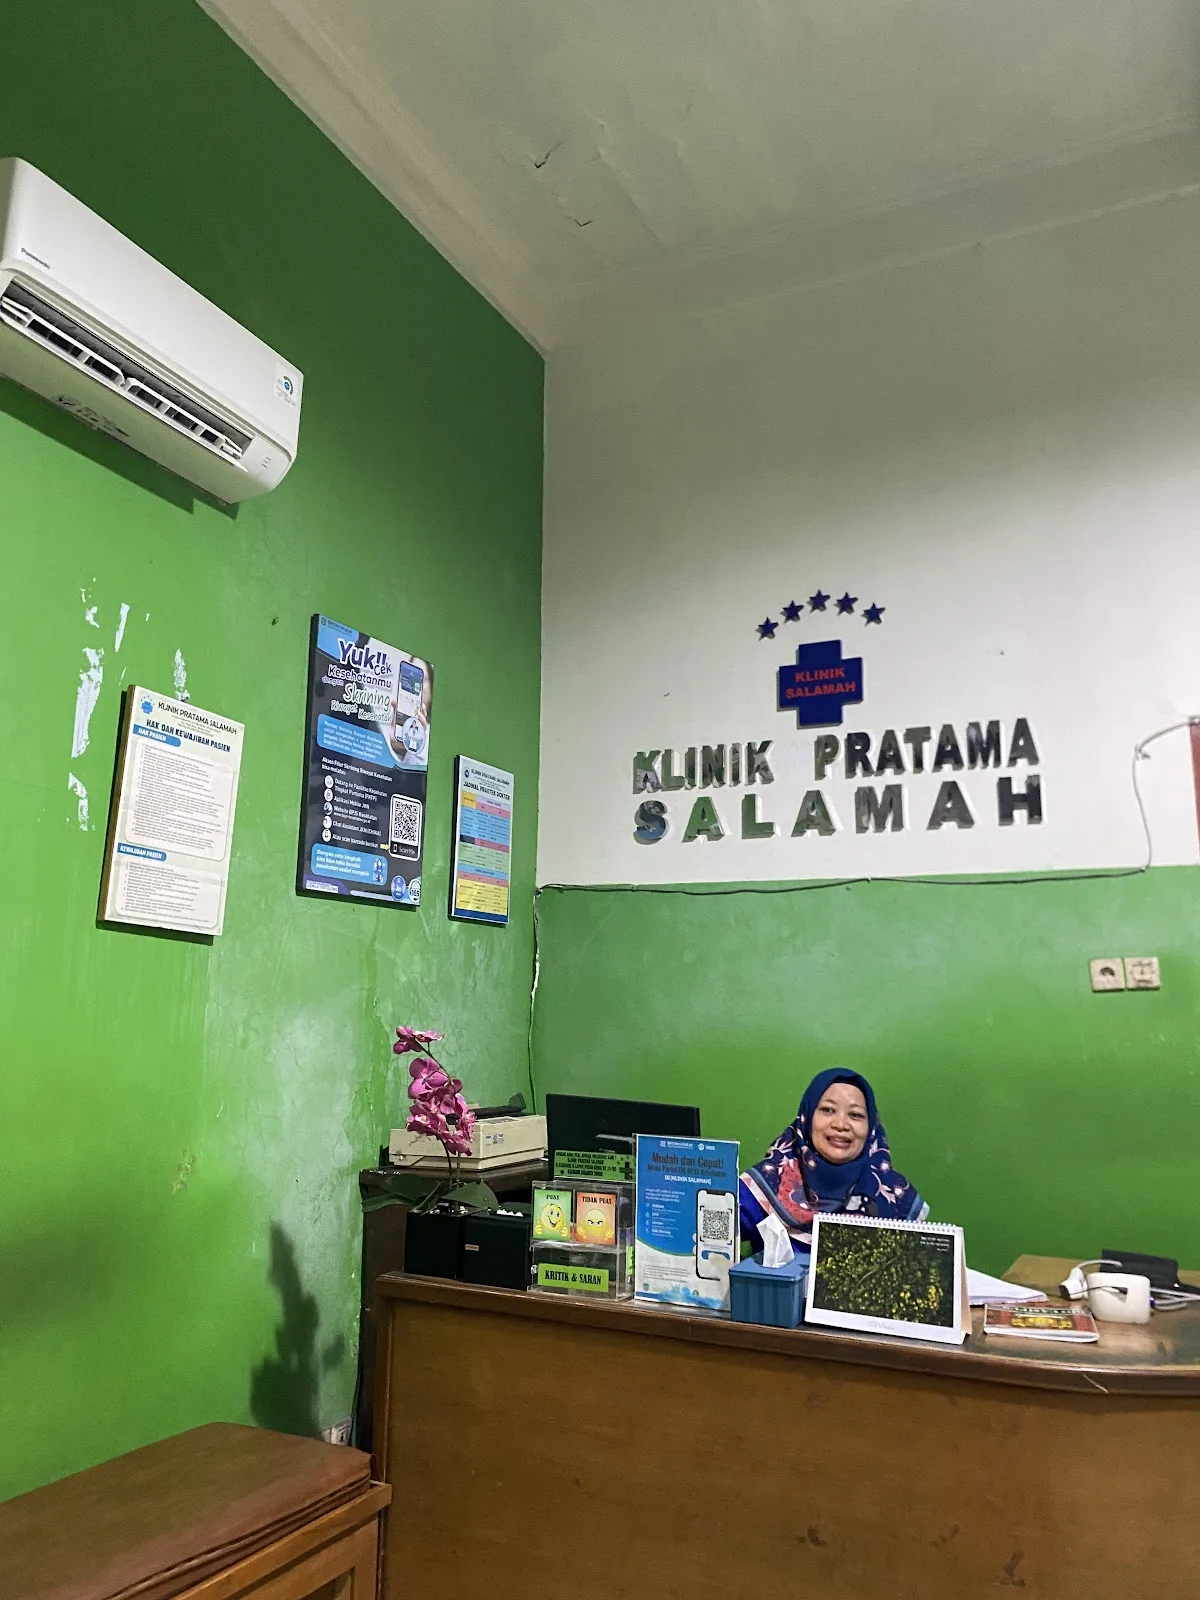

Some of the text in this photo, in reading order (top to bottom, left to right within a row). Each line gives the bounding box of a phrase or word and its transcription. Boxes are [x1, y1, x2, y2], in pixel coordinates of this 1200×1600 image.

[338, 639, 387, 670] Yuk!!
[328, 664, 392, 689] Kesehatanmu
[374, 662, 392, 676] Cek
[795, 667, 845, 683] KLINIK
[343, 682, 390, 712] Skrining
[785, 681, 857, 699] SALAMAH
[158, 701, 180, 716] KLINIK
[180, 708, 210, 726] PRATAMA
[210, 717, 237, 735] SALAMAH
[358, 708, 392, 723] Kesehatan
[137, 727, 167, 742] HAK PASIEN
[146, 719, 160, 731] HAK
[161, 723, 174, 734] DAN
[175, 727, 210, 746] KEWAJIBAN
[210, 739, 231, 753] PASIEN
[632, 717, 1041, 794] KLINIK PRATAMA
[632, 775, 1044, 845] SALAMAH
[410, 889, 420, 897] 165
[652, 1152, 679, 1165] Mudah
[680, 1154, 696, 1166] dan
[598, 1197, 612, 1205] PUAS
[545, 1269, 602, 1285] KRITIK & SARAN
